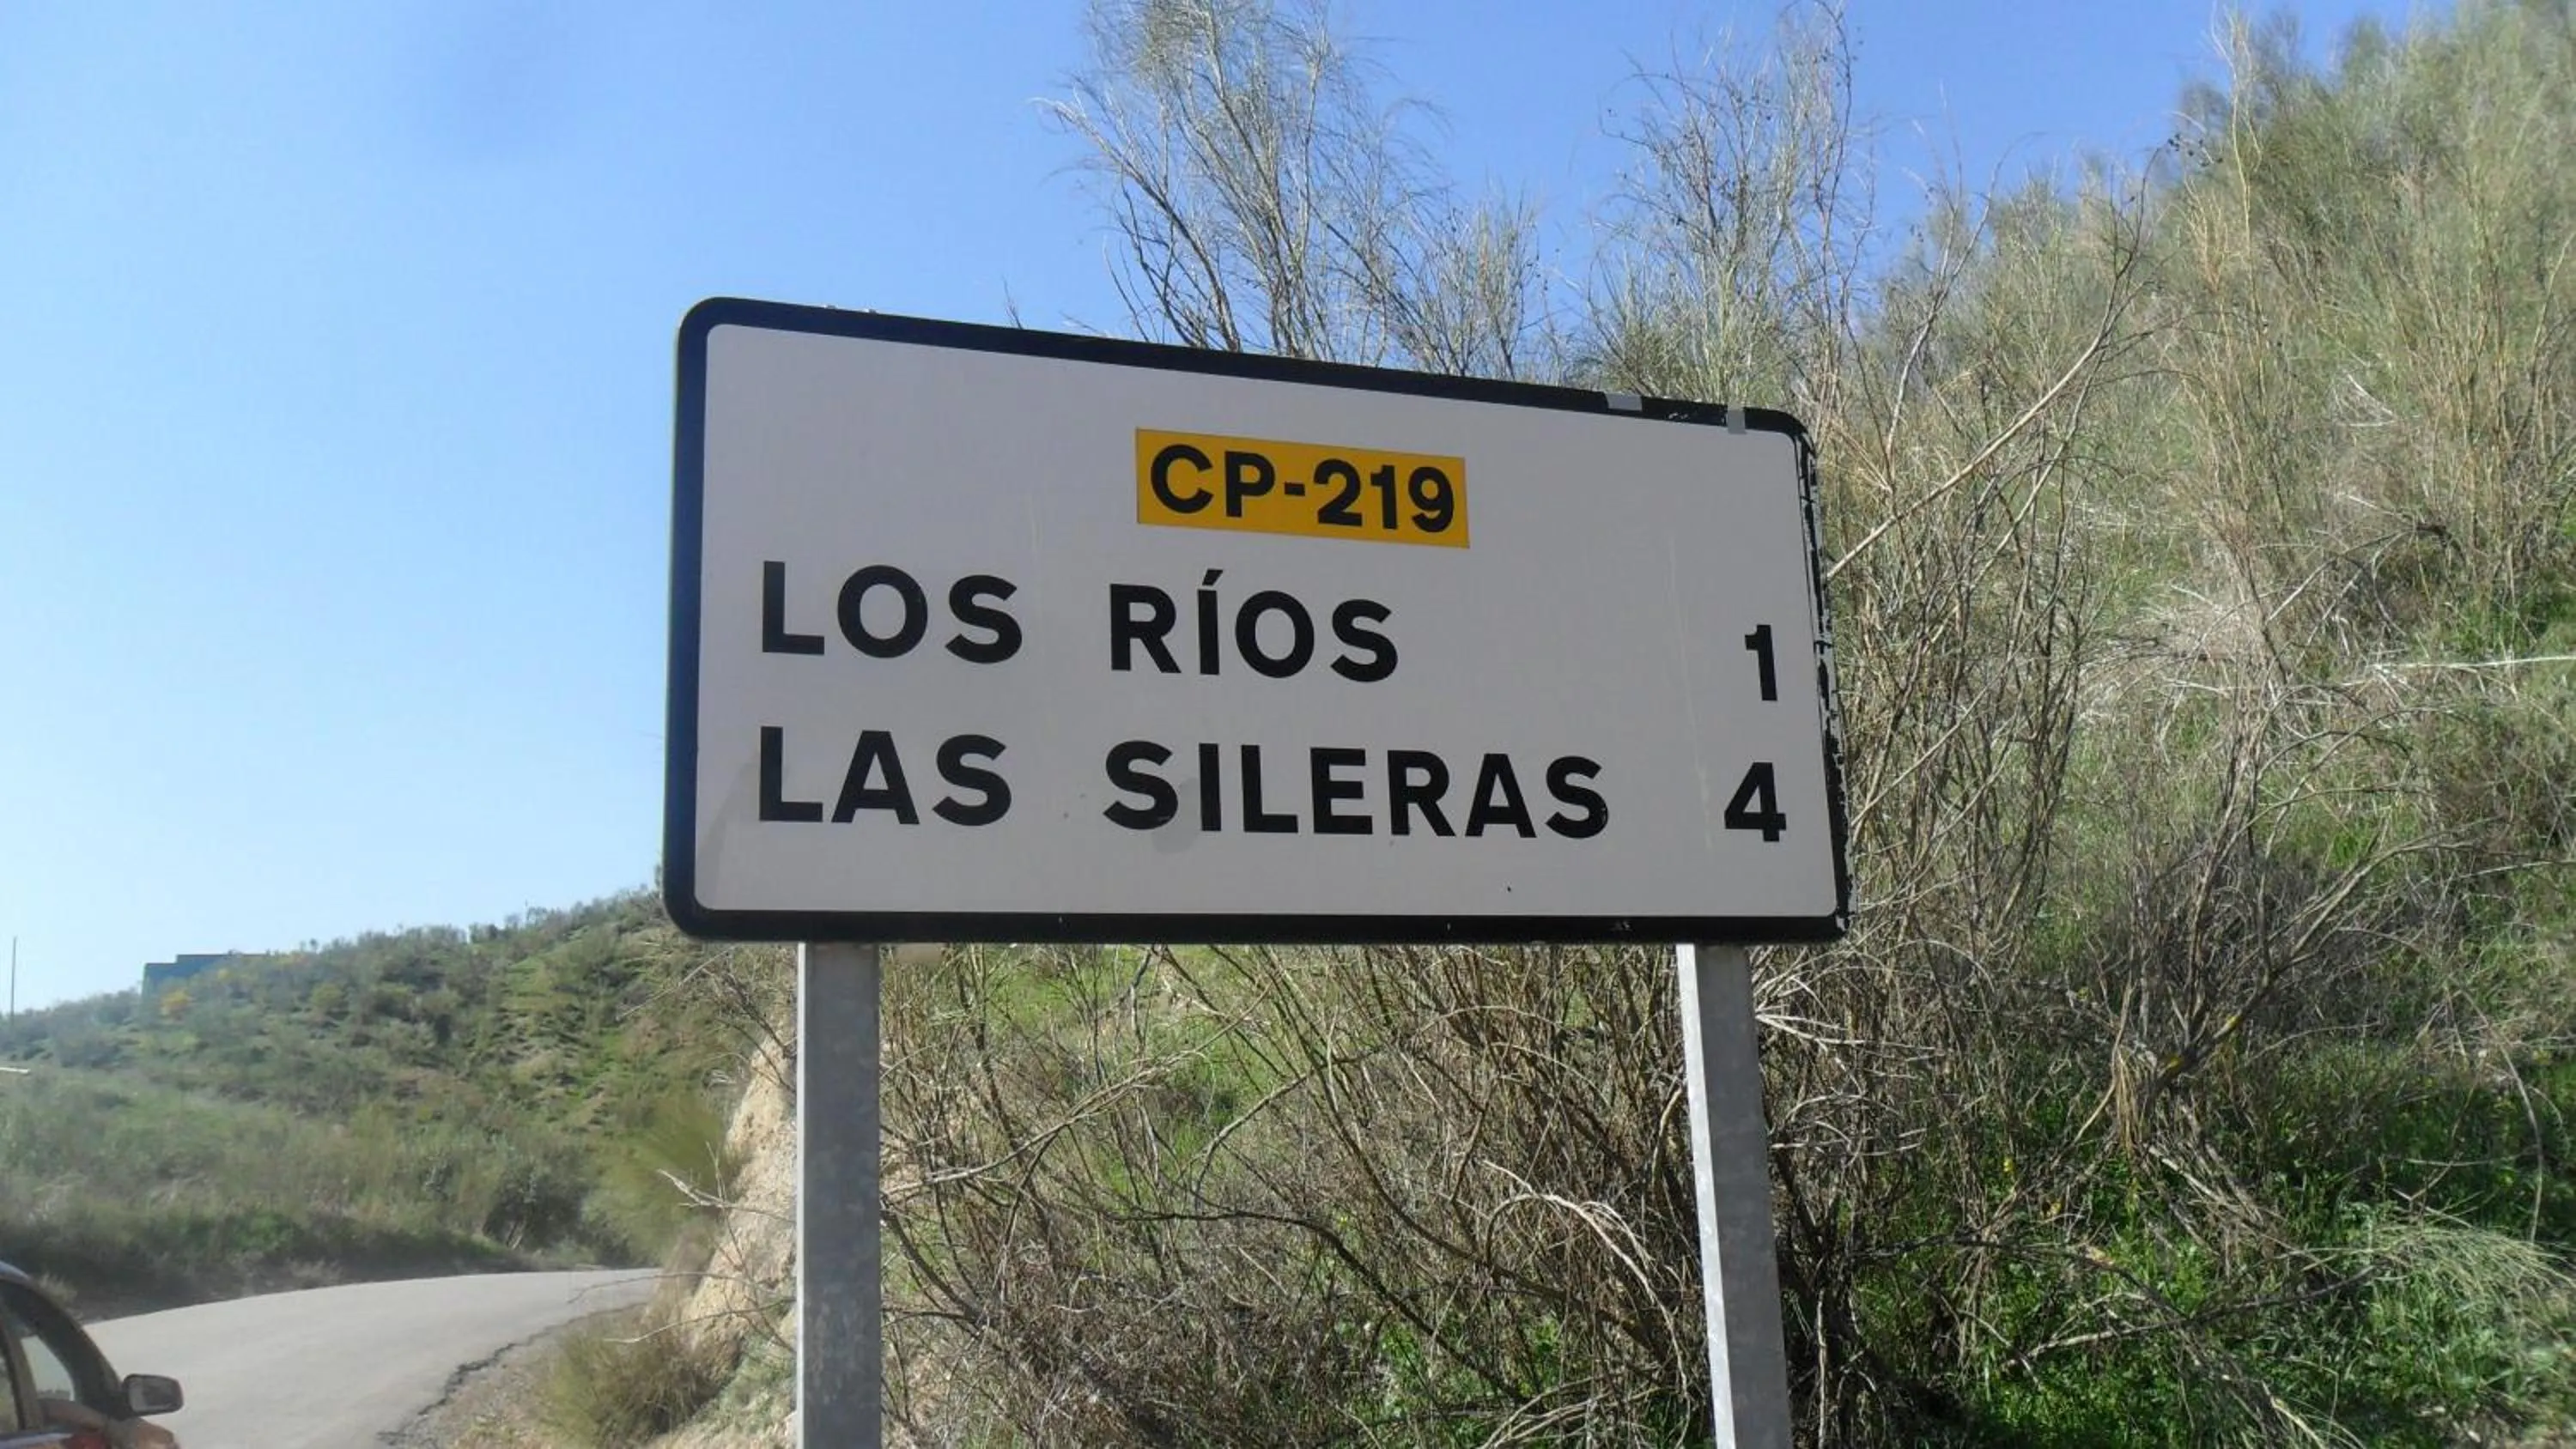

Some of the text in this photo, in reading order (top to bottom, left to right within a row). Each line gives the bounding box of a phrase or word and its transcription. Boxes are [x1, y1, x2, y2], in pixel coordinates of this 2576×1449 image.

[1149, 443, 1456, 535] CP-219
[761, 560, 1778, 702] LOS RÍOS 1
[758, 725, 1788, 843] LAS SILERAS 4
